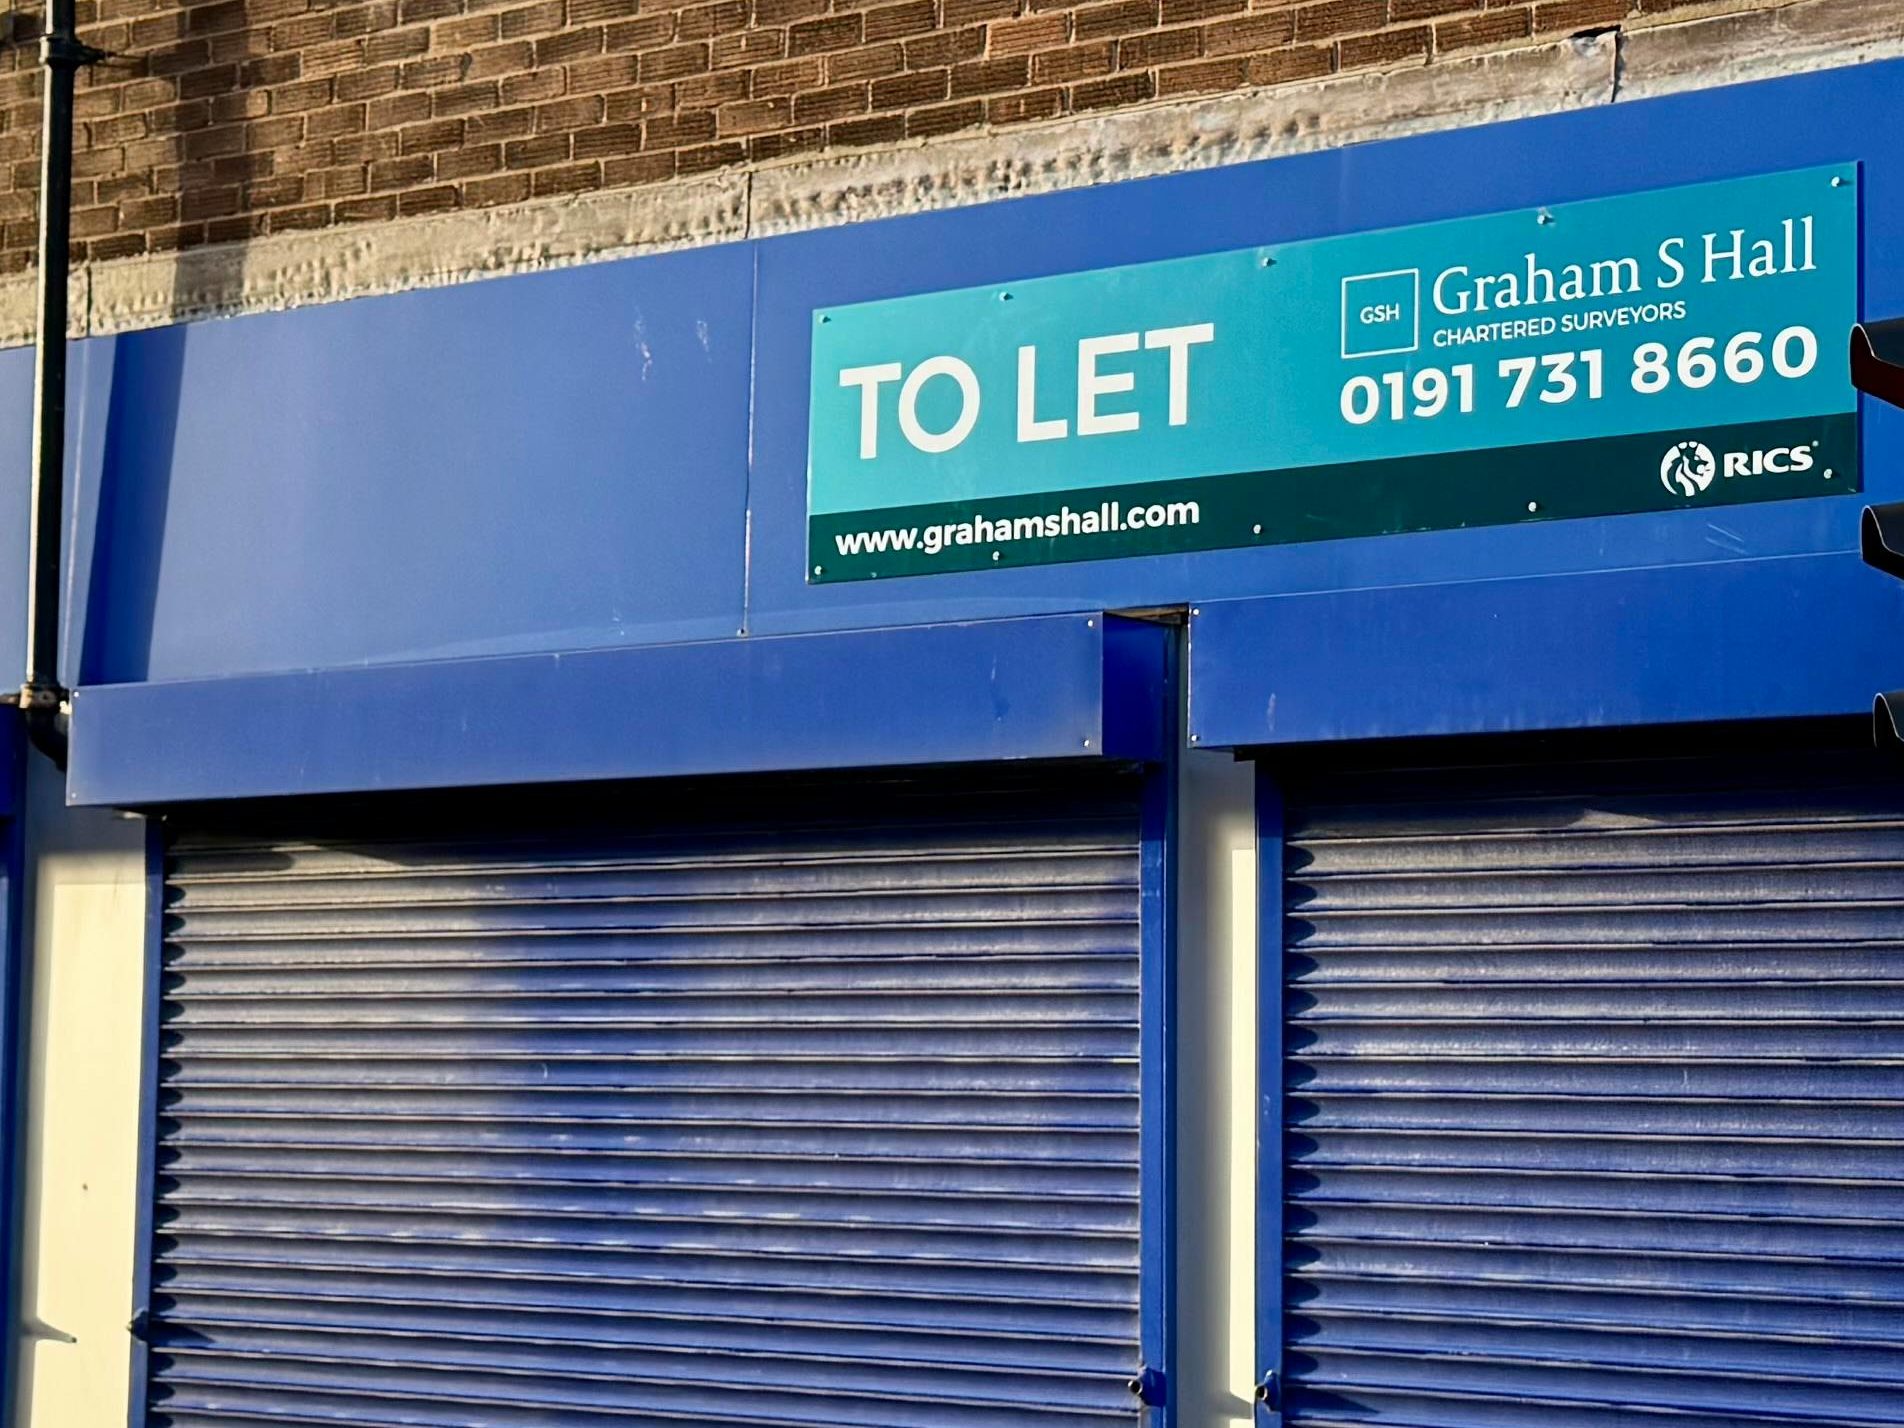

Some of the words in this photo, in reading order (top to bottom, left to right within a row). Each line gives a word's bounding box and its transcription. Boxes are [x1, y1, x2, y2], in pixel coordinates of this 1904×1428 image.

[1432, 253, 1642, 315] Graham
[1655, 237, 1686, 289] S
[1700, 215, 1817, 283] Hall
[1359, 303, 1400, 325] GSH
[1432, 317, 1556, 348] CHARTERED
[1560, 301, 1687, 332] SURVEYORS
[839, 355, 981, 460] TO
[1016, 323, 1215, 443] LET
[1339, 363, 1474, 426] 0191
[1498, 348, 1603, 408] 731
[1630, 325, 1818, 395] 8660
[1723, 445, 1814, 478] RICS
[835, 500, 1200, 556] www.grahamshall.com
